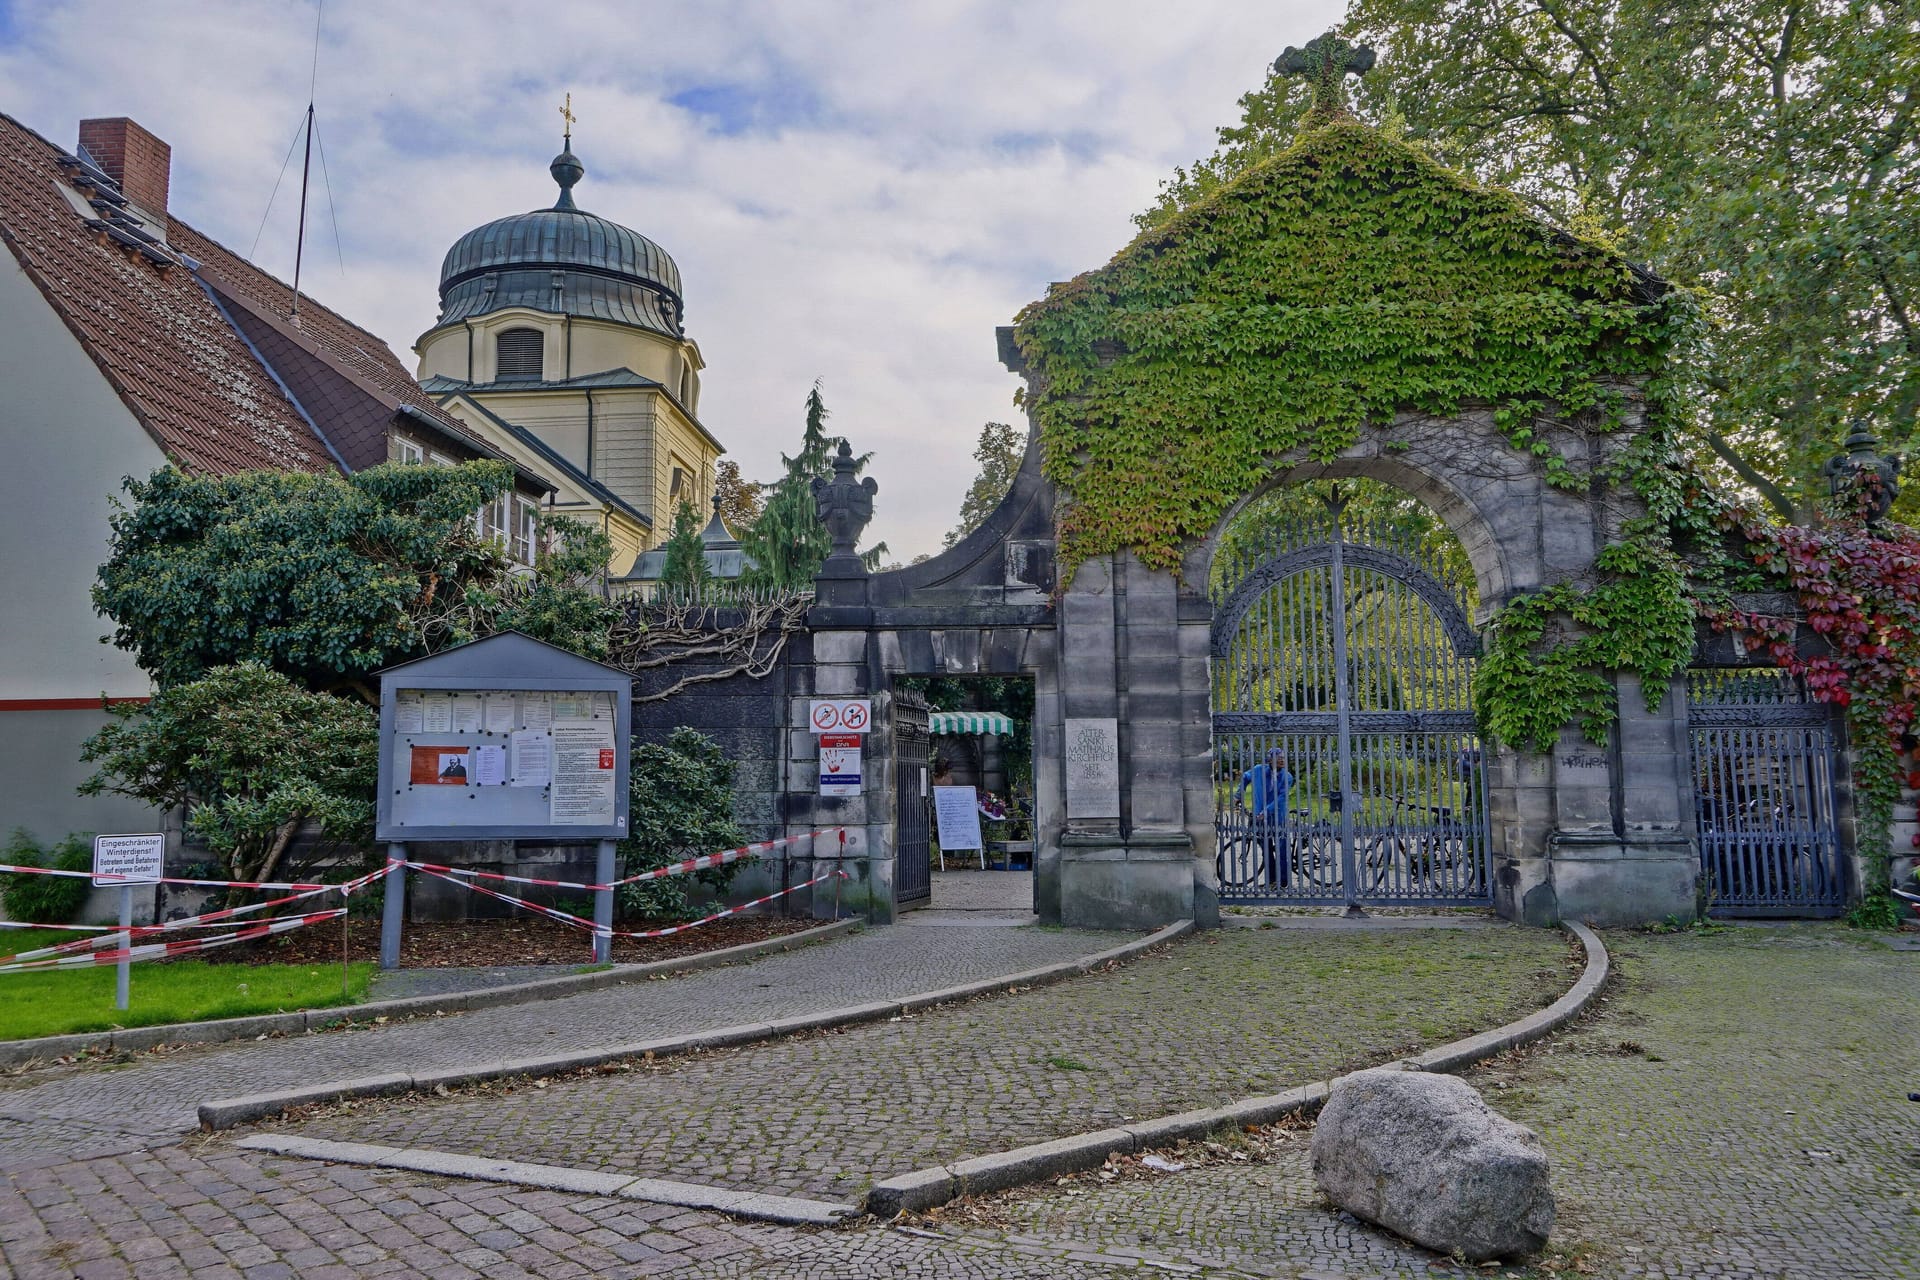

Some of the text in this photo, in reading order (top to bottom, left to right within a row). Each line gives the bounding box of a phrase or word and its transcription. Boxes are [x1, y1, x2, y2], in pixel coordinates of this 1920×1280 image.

[1077, 736, 1107, 745] SANKT
[101, 839, 160, 848] Eingeschränkter
[106, 847, 154, 856] Winterdienst!
[100, 858, 123, 866] Betreten
[135, 857, 159, 865] Befahren
[115, 866, 133, 875] eigene
